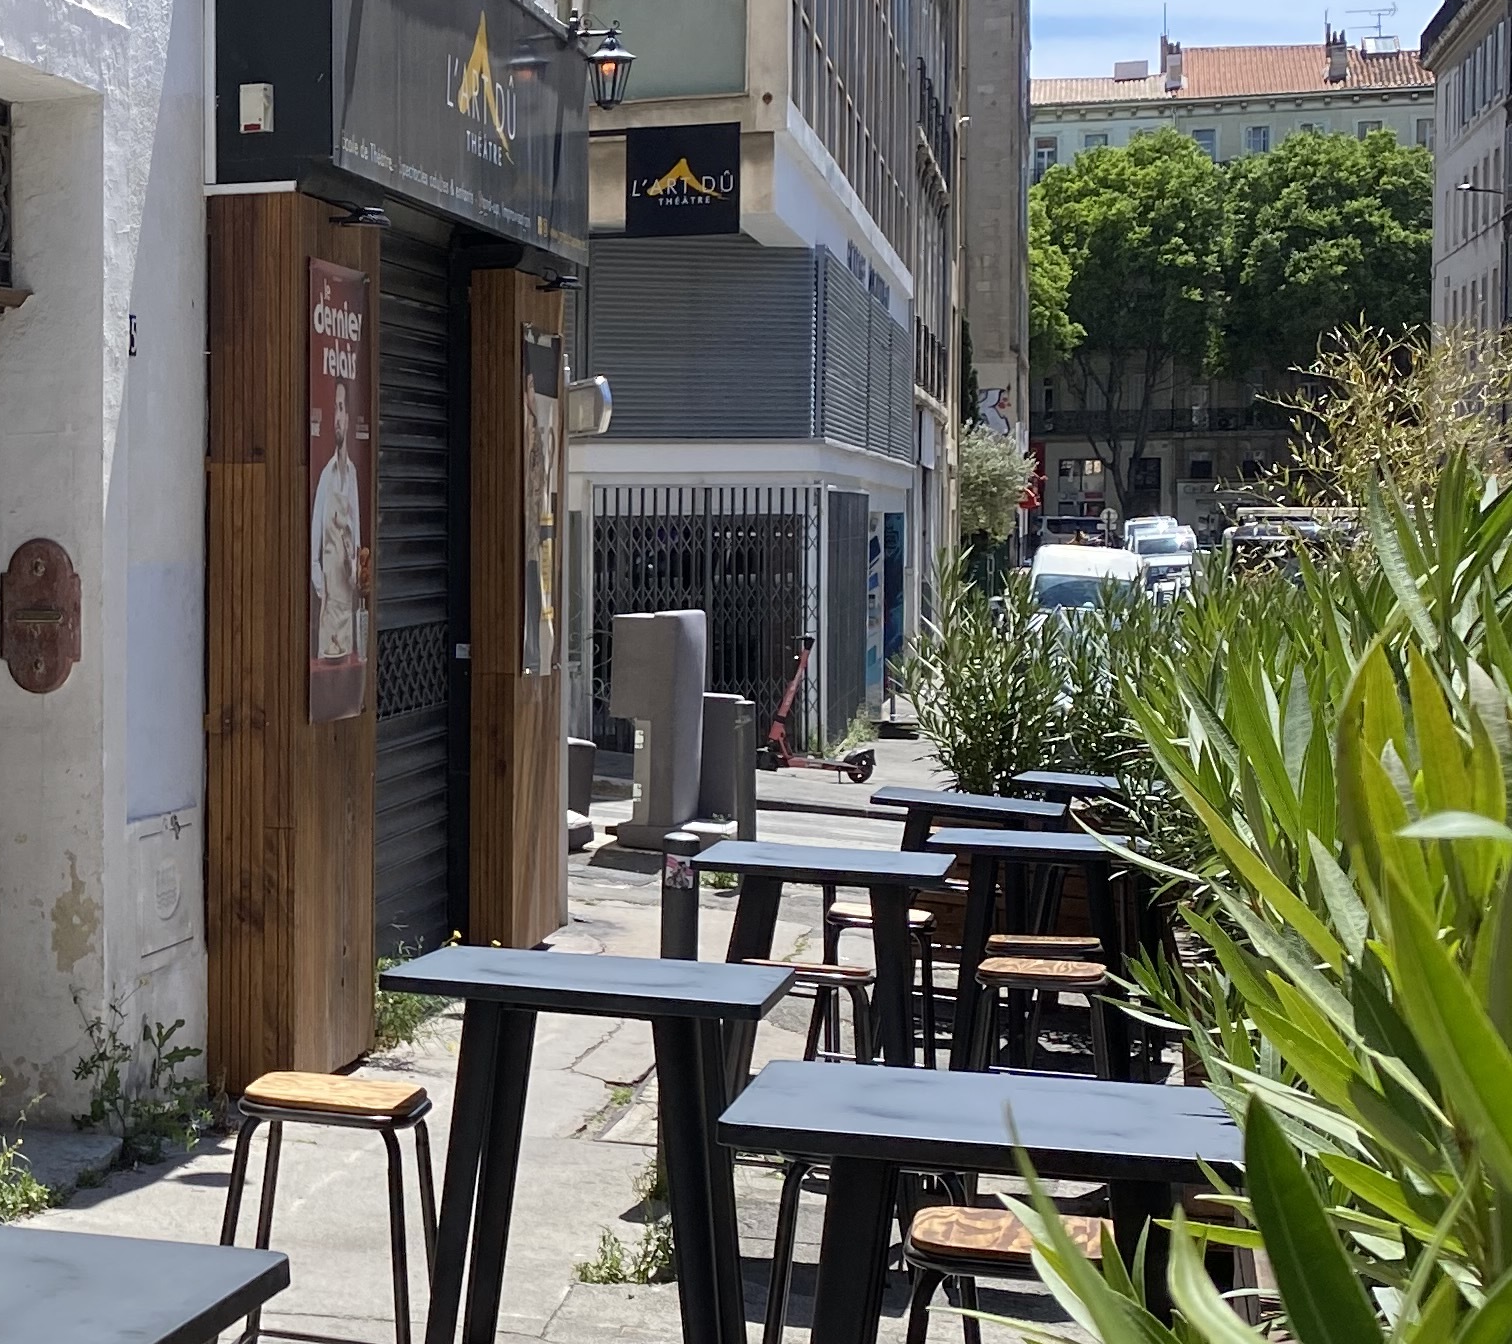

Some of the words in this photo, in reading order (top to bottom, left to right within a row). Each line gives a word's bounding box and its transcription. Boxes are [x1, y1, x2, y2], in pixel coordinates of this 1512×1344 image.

[446, 53, 489, 125] L'ART
[495, 74, 517, 141] DÛ
[465, 129, 503, 167] THÉÂTRE
[631, 177, 688, 197] L'ART
[701, 169, 734, 194] DÛ
[658, 196, 711, 206] THÉÂTRE
[323, 277, 331, 301] le
[322, 339, 357, 381] relais
